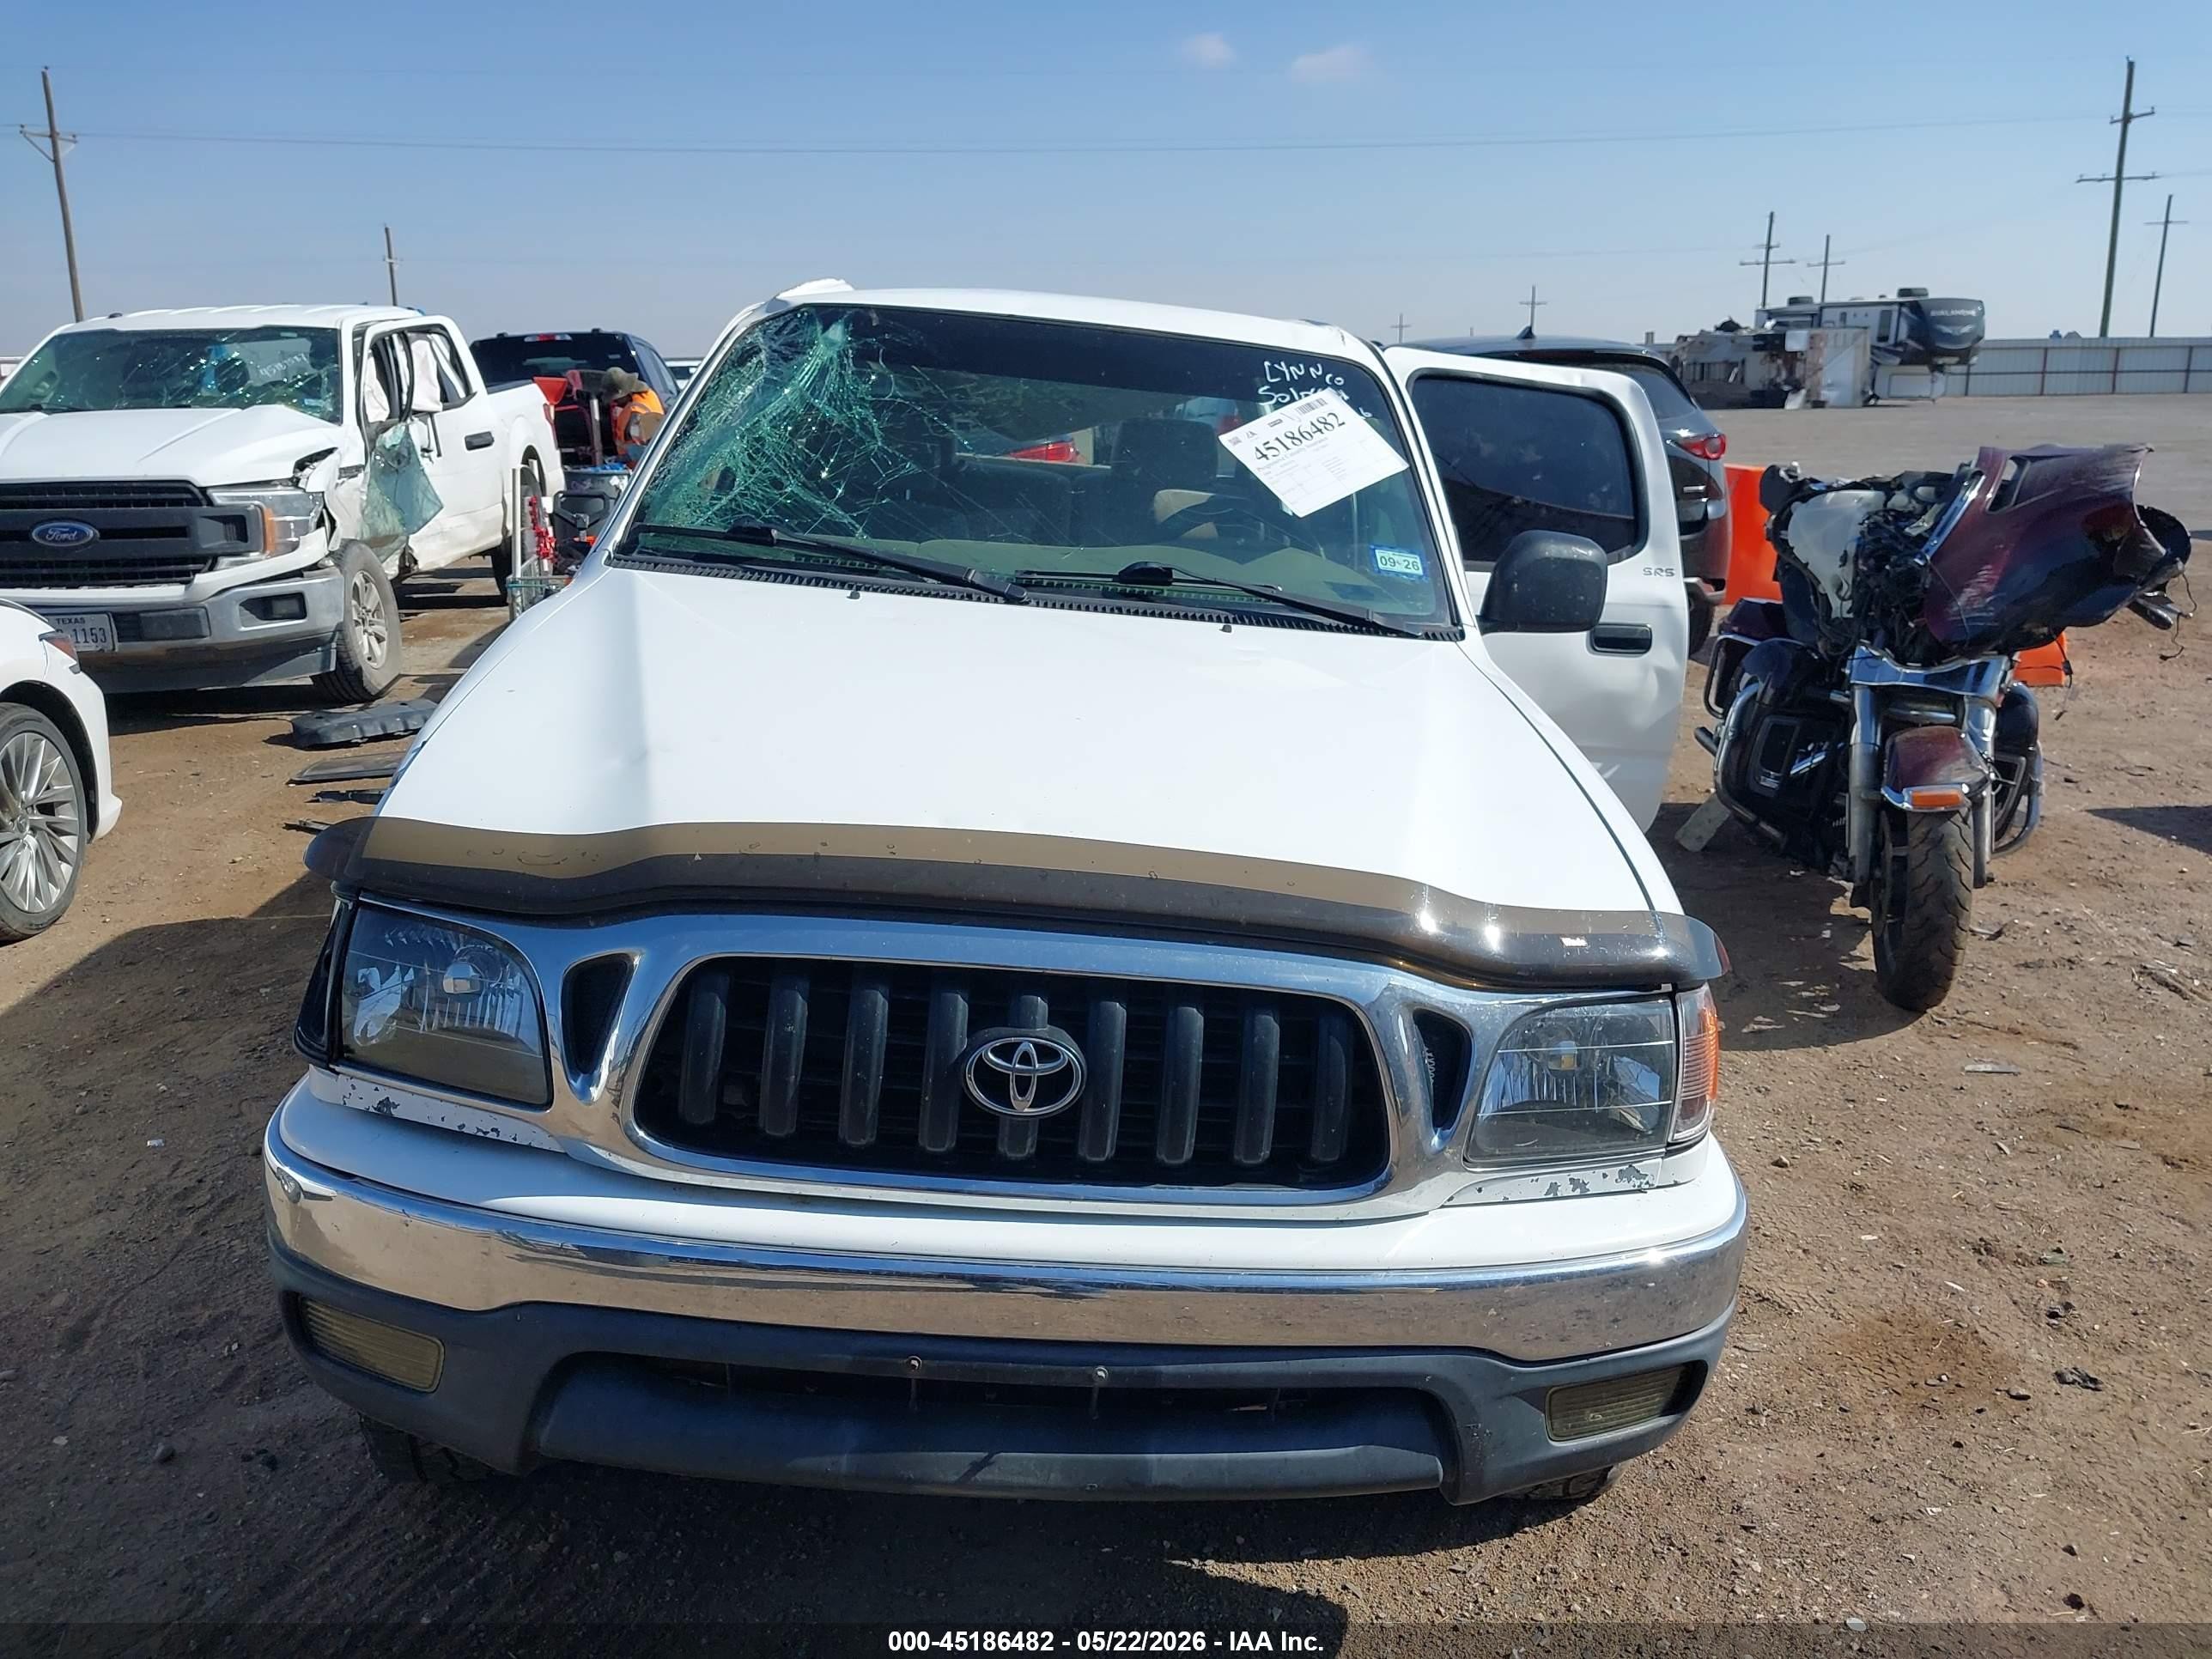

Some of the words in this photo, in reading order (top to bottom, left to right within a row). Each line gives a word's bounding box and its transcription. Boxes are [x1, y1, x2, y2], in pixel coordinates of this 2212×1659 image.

[1254, 412, 1346, 461] 45186482
[1380, 556, 1396, 568] 09
[1402, 559, 1419, 571] 26
[55, 617, 86, 626] TEXAS
